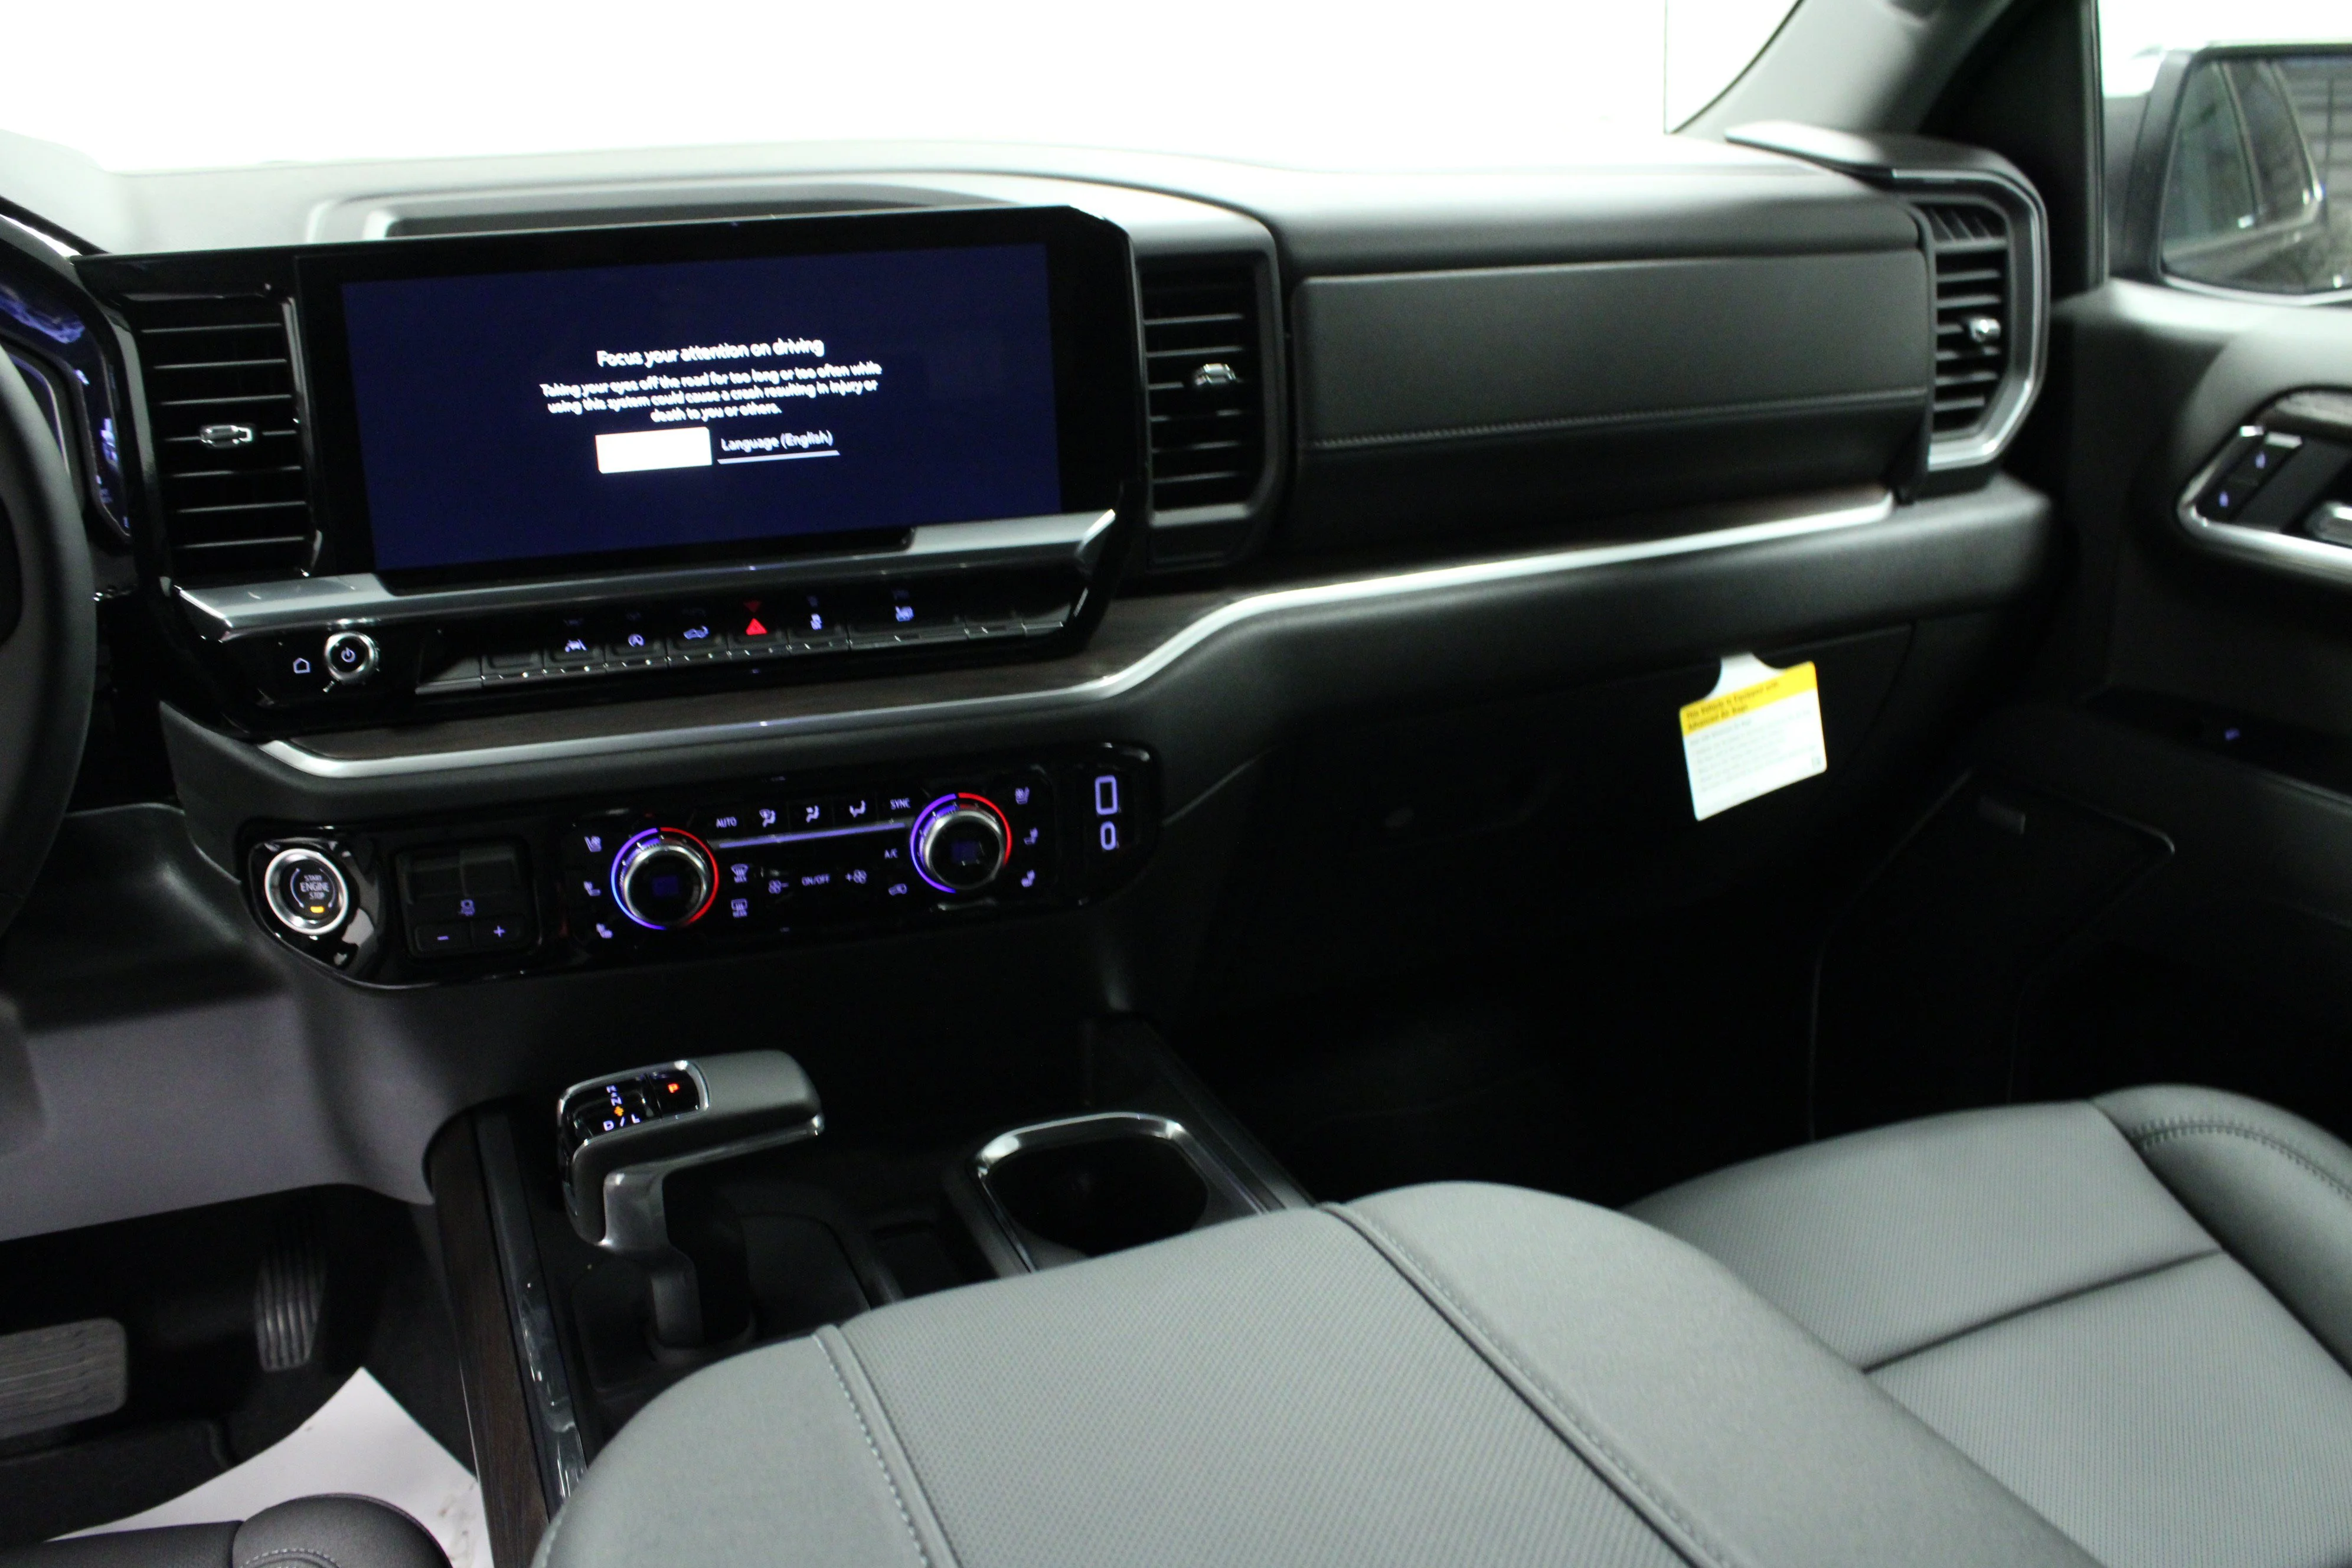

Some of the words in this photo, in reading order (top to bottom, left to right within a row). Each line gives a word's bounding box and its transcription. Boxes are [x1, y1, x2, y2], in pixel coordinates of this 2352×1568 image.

[597, 350, 643, 367] Focus
[644, 349, 678, 368] your
[681, 342, 749, 361] attention
[750, 343, 771, 357] on
[772, 338, 824, 357] driving
[539, 383, 581, 398] Taking
[581, 383, 609, 397] your
[609, 381, 639, 395] eyes
[639, 375, 658, 390] off
[659, 375, 680, 389] the
[681, 372, 710, 387] road
[710, 371, 729, 386] for
[729, 371, 751, 384] too
[751, 368, 779, 384] long
[779, 370, 795, 381] or
[794, 367, 816, 379] too
[816, 363, 850, 378] often
[850, 361, 882, 375] while
[547, 400, 583, 415] using
[582, 397, 607, 411] this
[607, 396, 651, 412] system
[651, 390, 685, 406] could
[685, 391, 720, 404] cause
[721, 390, 730, 401] a
[730, 385, 764, 400] crash
[764, 383, 816, 398] resulting
[816, 381, 829, 394] in
[829, 380, 863, 396] injury
[864, 380, 878, 391] or
[651, 408, 687, 423] death
[686, 407, 701, 420] to
[700, 407, 724, 422] you
[724, 406, 739, 417] or
[739, 401, 782, 416] others.
[721, 438, 779, 453] Language
[780, 430, 833, 450] (English)
[890, 798, 911, 811] SYNC
[716, 816, 737, 828] AUTO
[884, 848, 898, 859] A/C
[801, 874, 831, 886] ON/OFF
[300, 882, 330, 893] ENGINE
[309, 891, 325, 900] STOP
[667, 1083, 680, 1093] P
